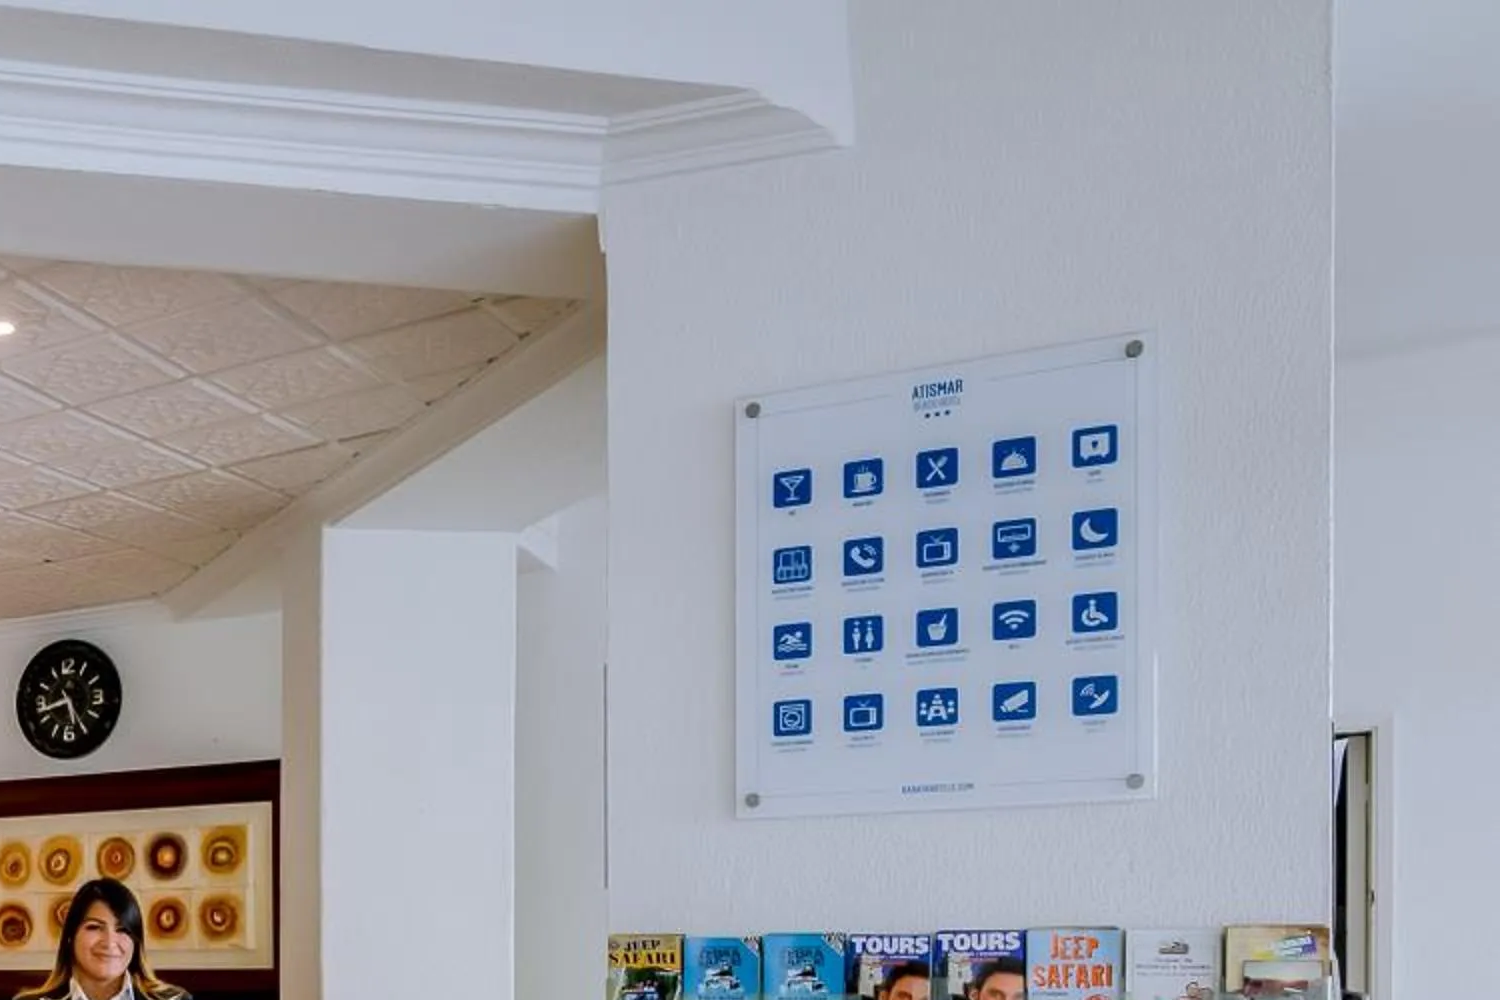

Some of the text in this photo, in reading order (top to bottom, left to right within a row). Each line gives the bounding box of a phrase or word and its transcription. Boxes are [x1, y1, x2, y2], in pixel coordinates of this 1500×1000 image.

[911, 379, 964, 400] ATISMAR
[61, 658, 76, 675] 12
[92, 688, 104, 705] 3
[63, 725, 75, 742] 6
[624, 939, 661, 952] JEEP
[852, 936, 929, 954] TOURS
[937, 932, 1021, 951] TOURS
[1050, 930, 1100, 960] JEEP
[609, 951, 676, 965] SAFARI
[1032, 963, 1113, 989] SAFARI
